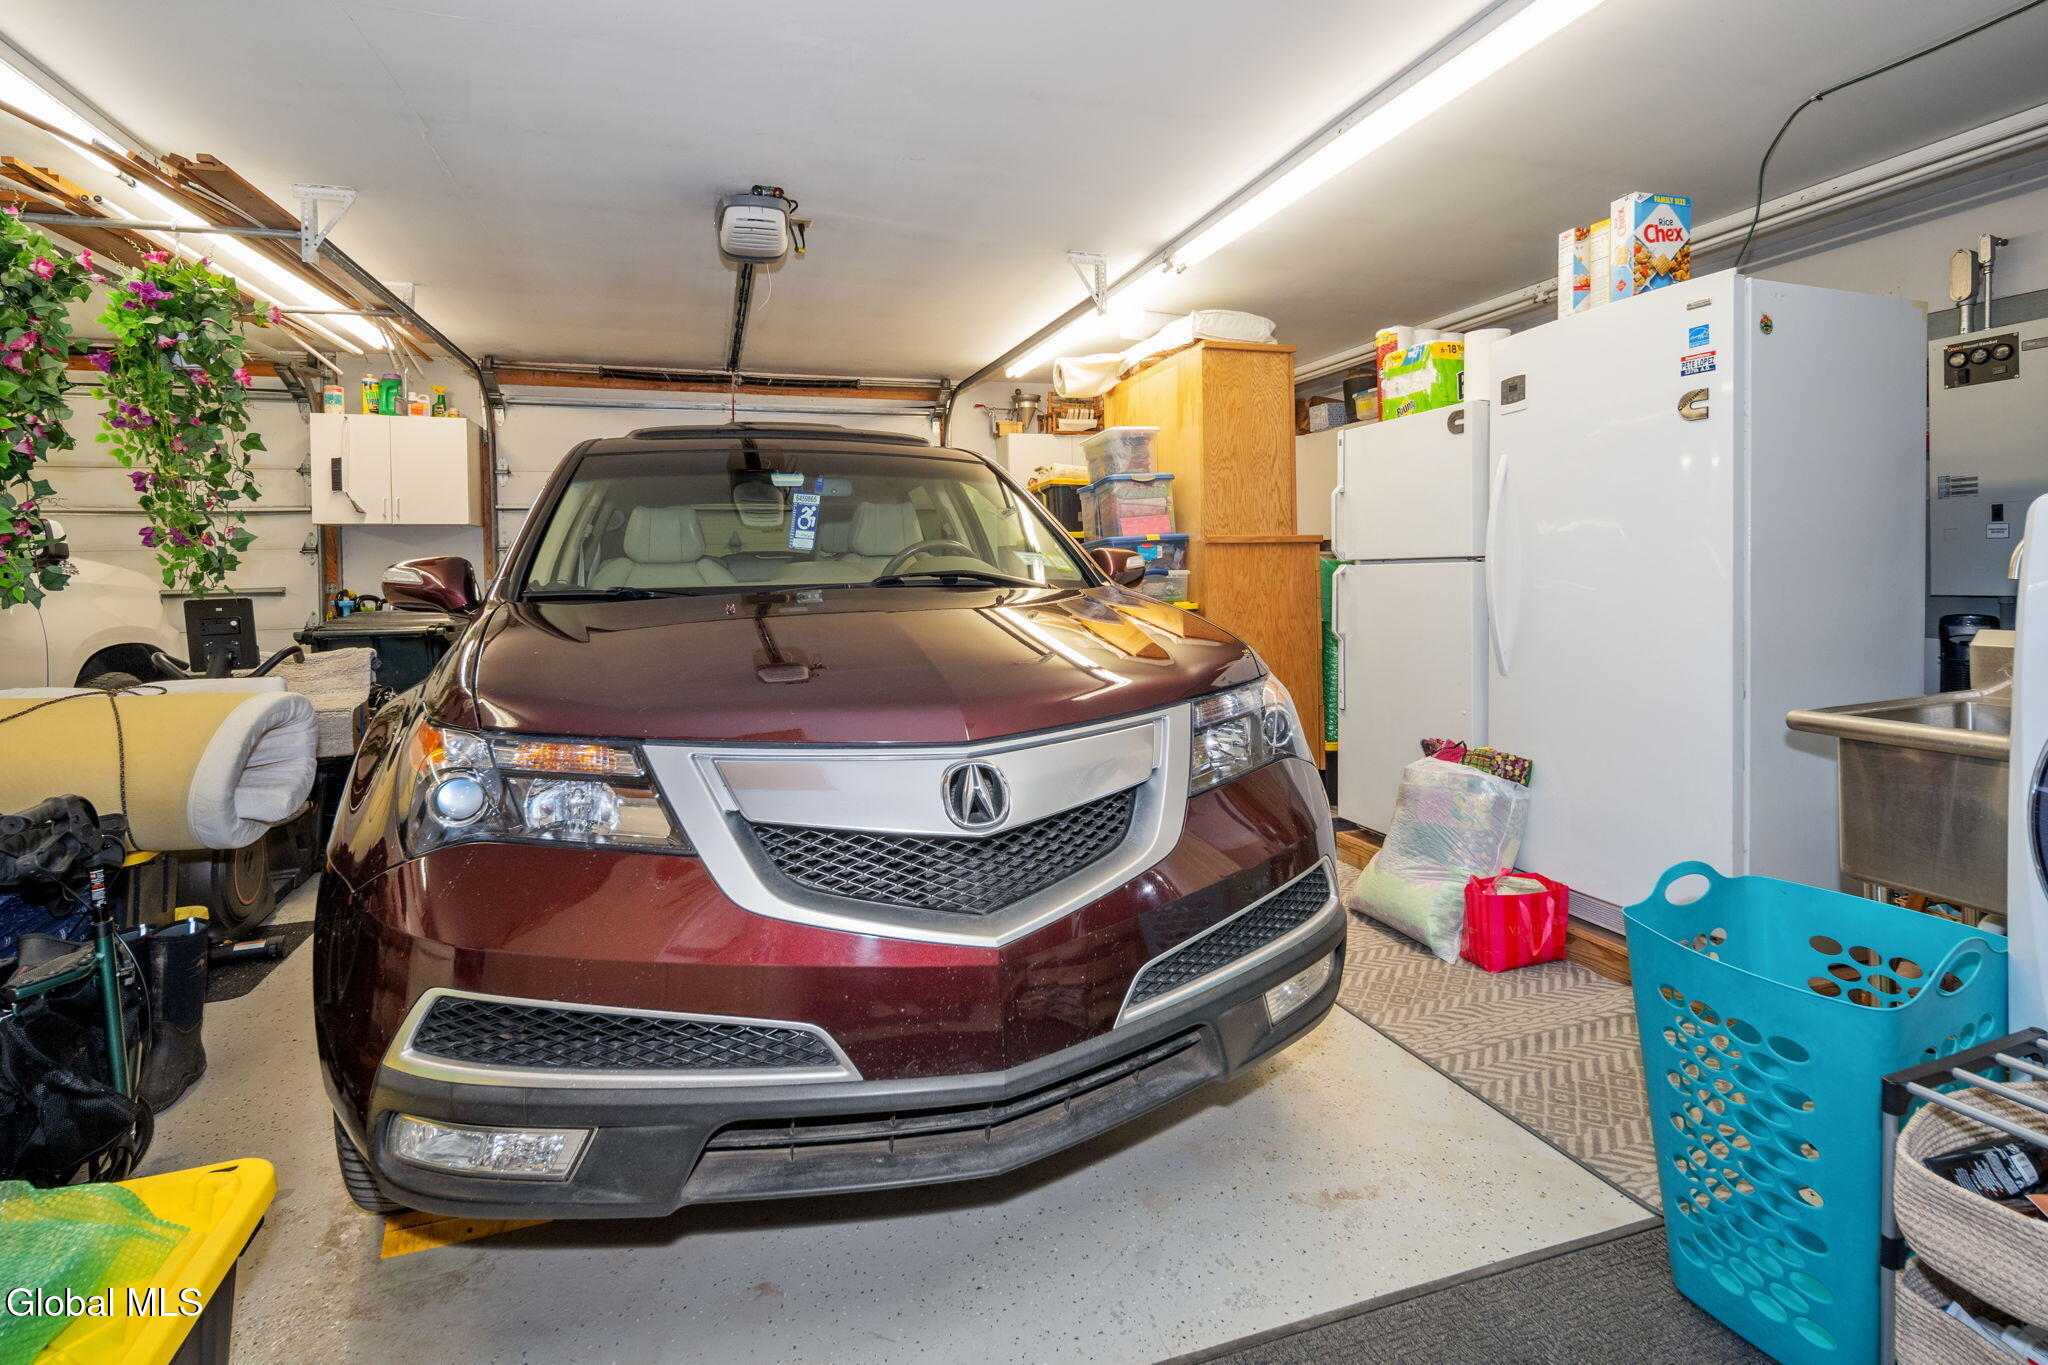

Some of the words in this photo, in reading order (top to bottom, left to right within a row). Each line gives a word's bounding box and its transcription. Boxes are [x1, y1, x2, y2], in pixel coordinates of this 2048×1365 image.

[1654, 195, 1672, 204] FAMILY
[1674, 198, 1687, 206] SIZE
[1658, 218, 1674, 226] Rice
[1643, 224, 1684, 243] Chex
[1681, 360, 1695, 369] PETE
[1697, 356, 1715, 367] LOPEZ
